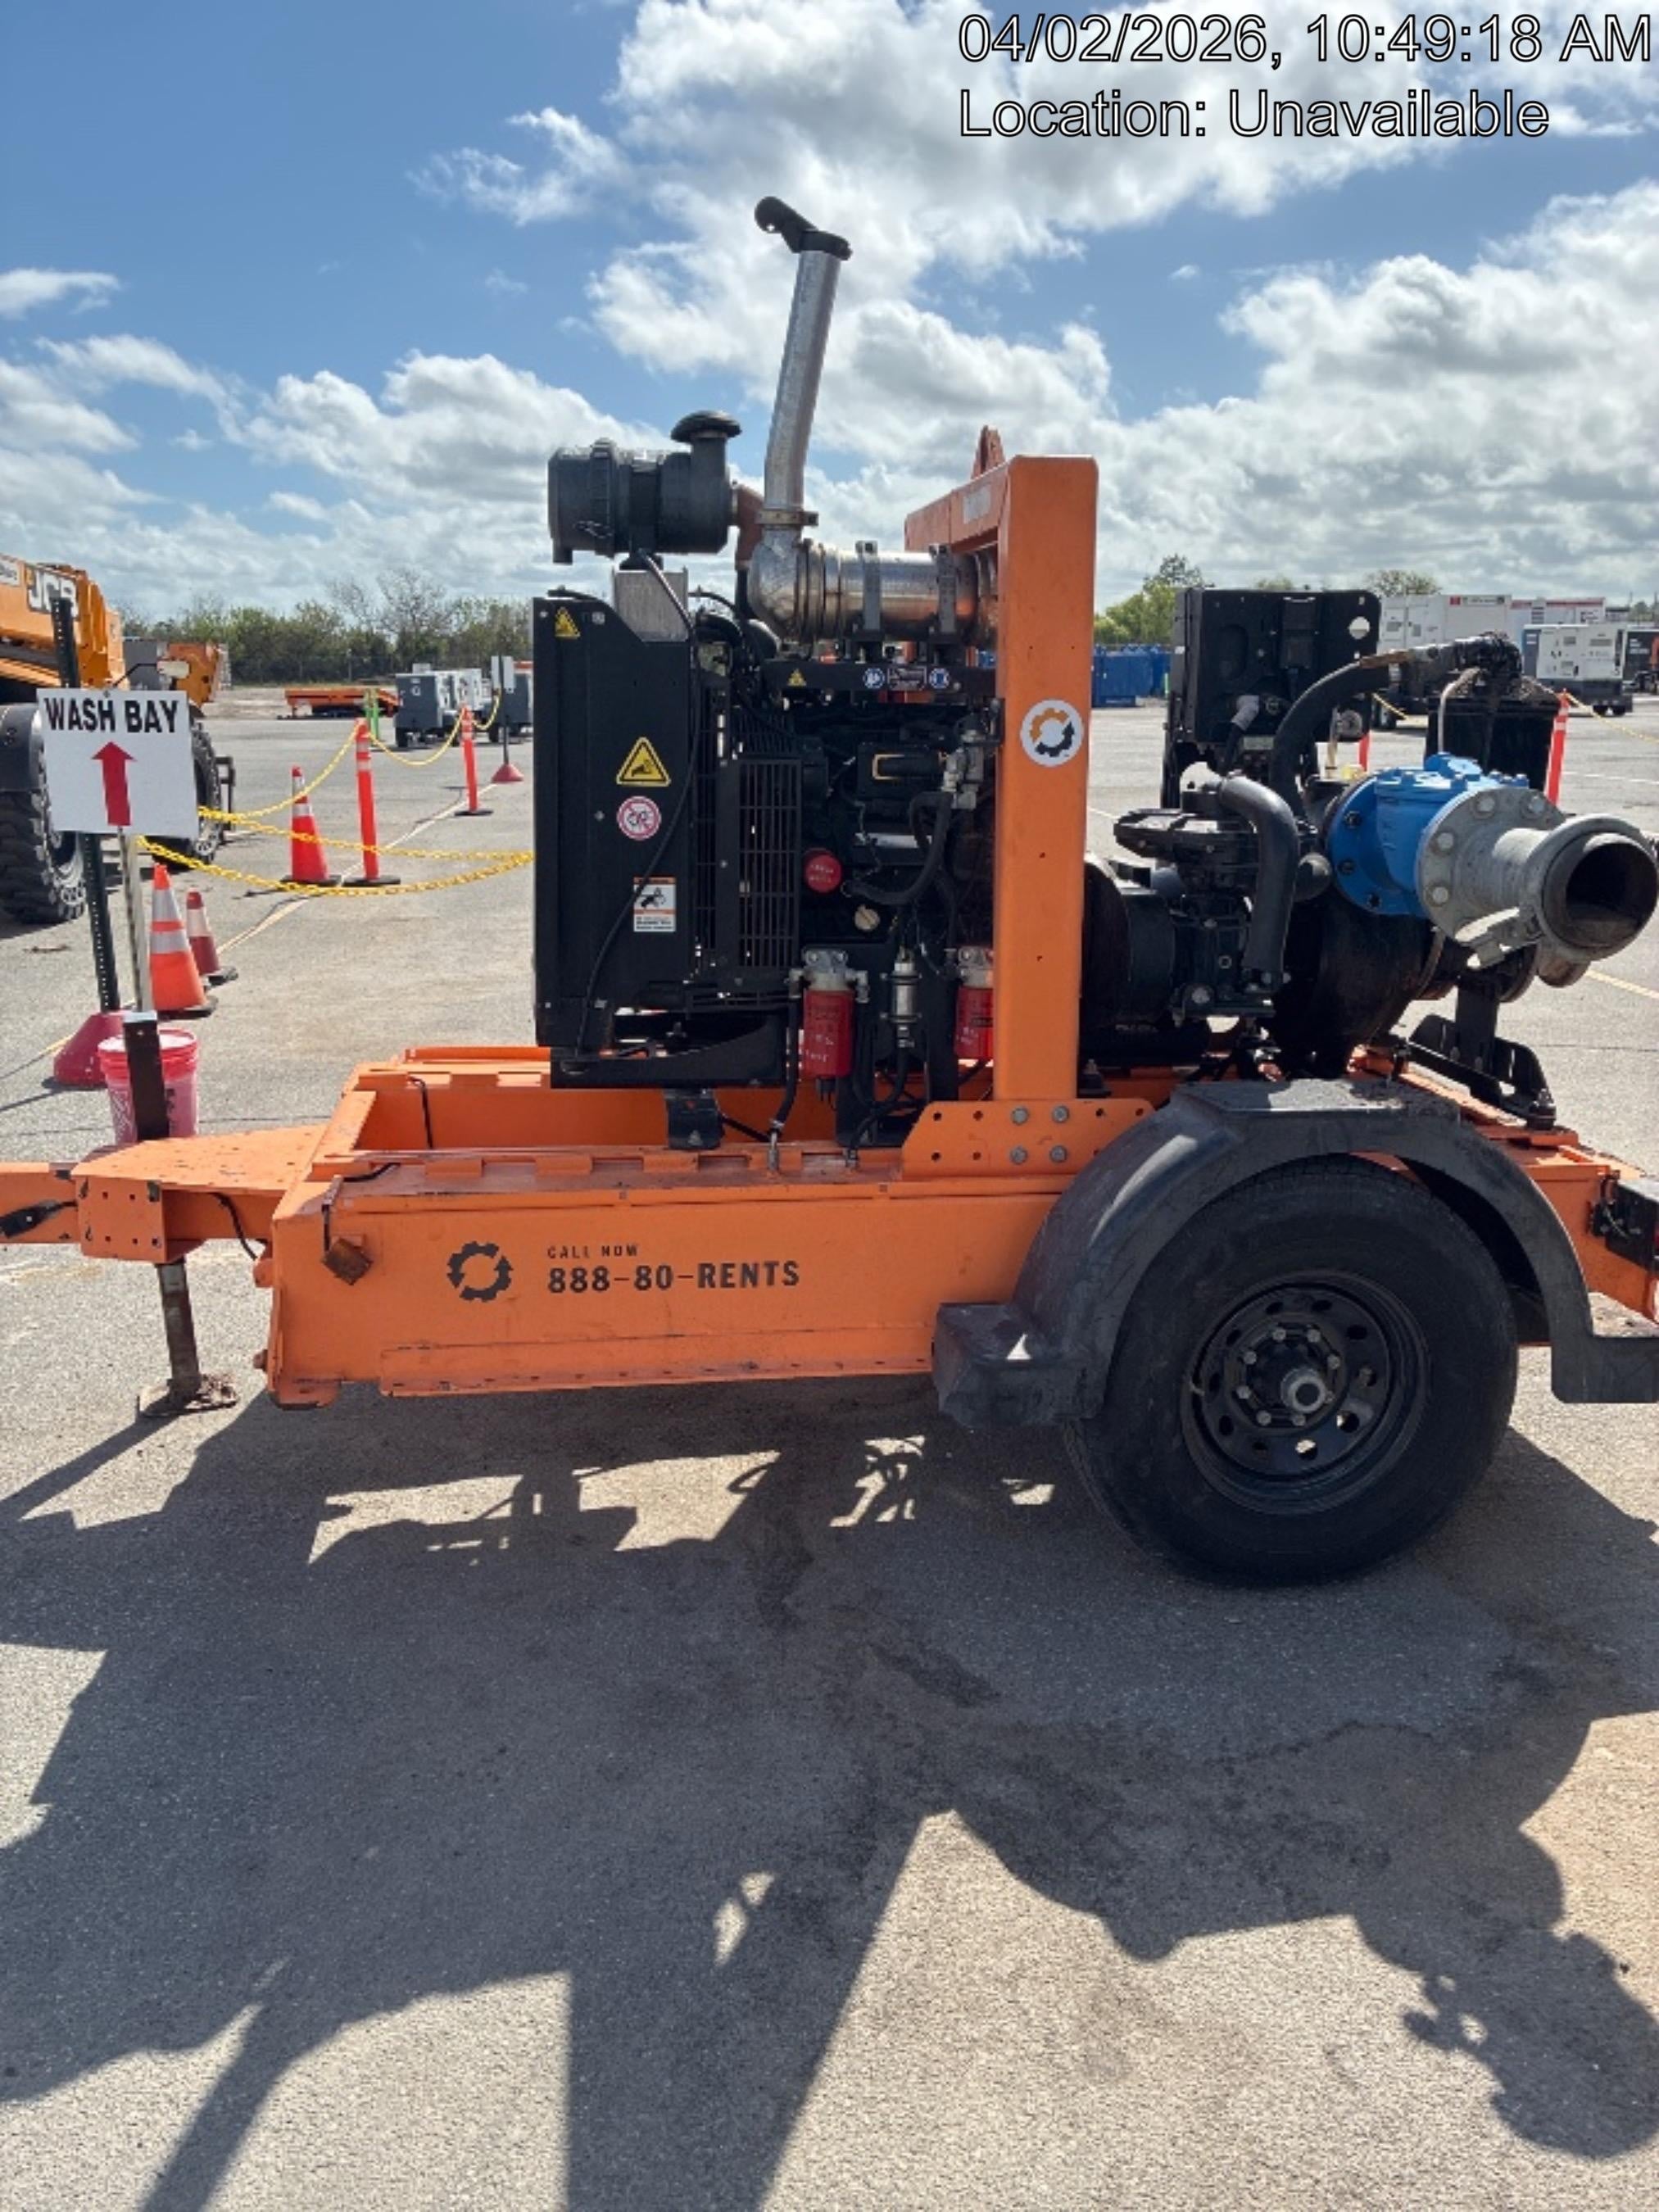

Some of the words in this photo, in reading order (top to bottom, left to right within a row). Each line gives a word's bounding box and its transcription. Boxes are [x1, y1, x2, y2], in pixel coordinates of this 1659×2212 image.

[28, 569, 79, 619] JCB
[44, 697, 116, 732] WASH
[125, 700, 179, 733] BAY
[547, 1245, 590, 1258] CALL
[601, 1244, 638, 1257] NOW
[548, 1260, 800, 1294] 888-80-RENTS
